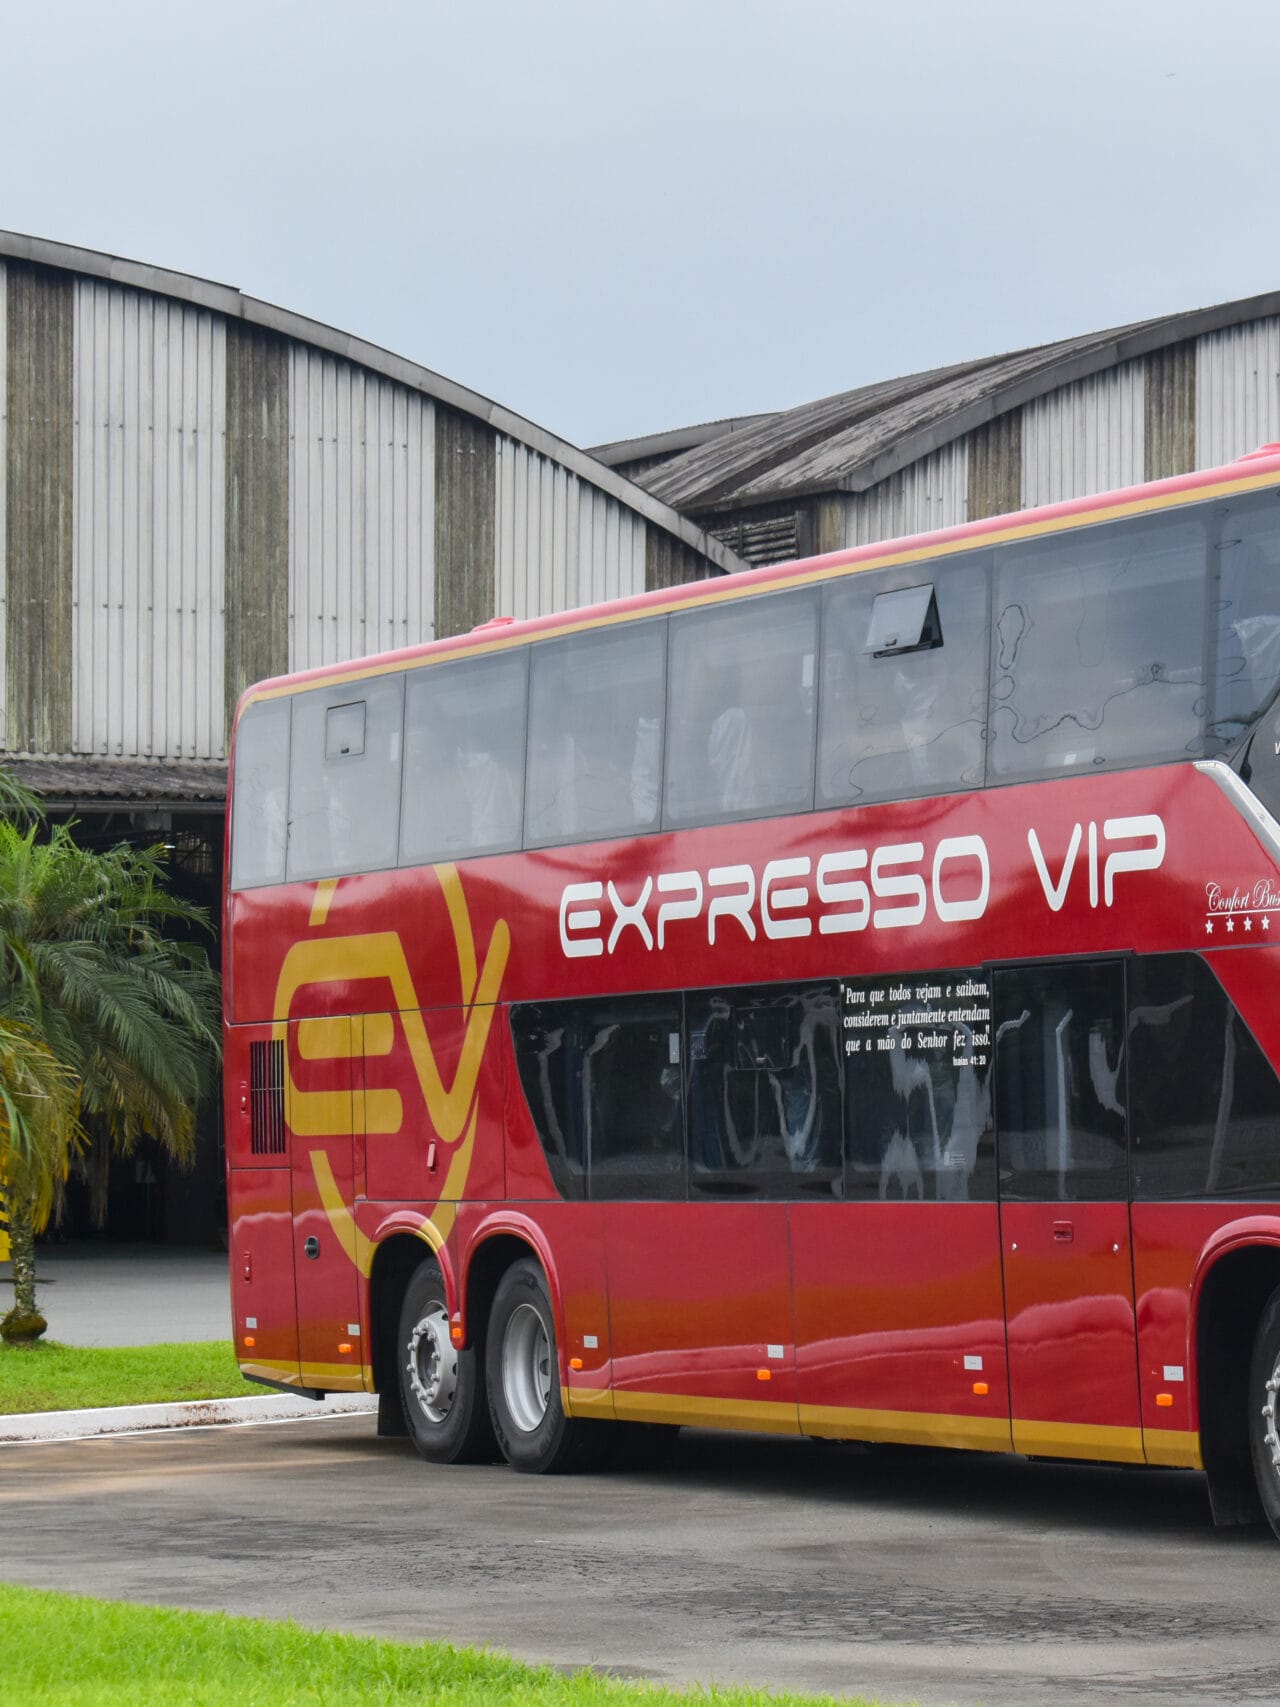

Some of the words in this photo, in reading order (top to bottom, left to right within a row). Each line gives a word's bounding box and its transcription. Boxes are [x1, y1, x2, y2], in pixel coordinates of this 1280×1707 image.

[558, 834, 990, 958] EXPRESSO
[1028, 813, 1167, 912] VIP
[869, 989, 885, 1006] que
[889, 984, 912, 1000] todos
[916, 983, 942, 1003] vejam
[946, 985, 952, 997] e
[956, 979, 990, 999] saibam,
[843, 1010, 889, 1028] considerem
[891, 1013, 897, 1026] e
[896, 1008, 946, 1030] juntamente
[948, 1004, 990, 1023] entendam
[845, 1039, 861, 1057] que
[866, 1039, 872, 1051] a
[877, 1034, 896, 1051] mão
[901, 1032, 912, 1049] do
[917, 1030, 948, 1049] Senhor
[953, 1030, 966, 1051] fez
